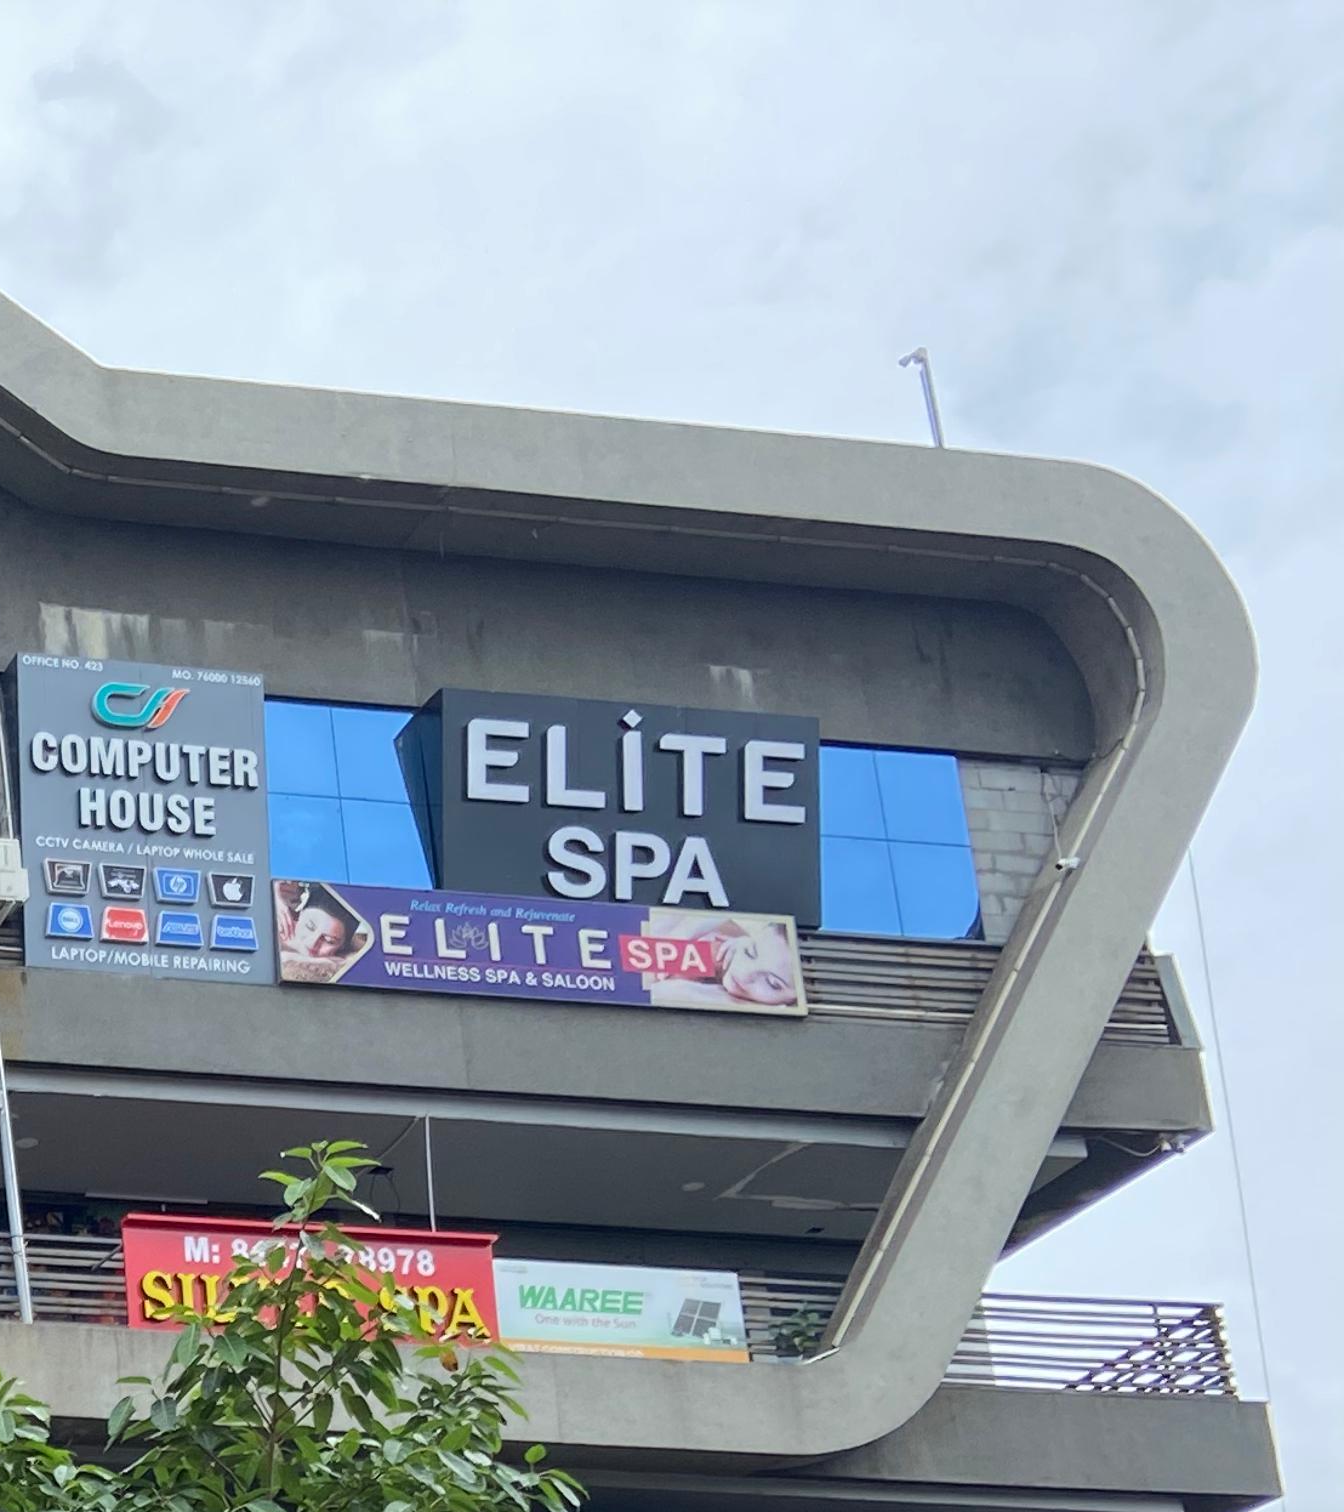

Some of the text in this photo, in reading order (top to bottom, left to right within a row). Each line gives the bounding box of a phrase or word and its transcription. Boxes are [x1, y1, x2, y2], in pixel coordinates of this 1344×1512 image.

[22, 655, 104, 672] OFFICE NO. 423
[172, 669, 194, 682] MO.
[31, 731, 260, 789] COMPUTER
[78, 786, 218, 837] HOUSE
[35, 835, 69, 848] CCTV
[72, 838, 125, 854] CAMERA
[136, 844, 181, 858] LAPTOP
[182, 847, 225, 862] WHOLE
[227, 851, 255, 865] SALE
[546, 825, 730, 908] SPA
[410, 899, 442, 913] Relax
[445, 902, 487, 916] Refresh
[490, 906, 512, 918] and
[381, 913, 707, 973] ELITE SPA
[51, 946, 251, 973] LAPTOP/MOBILE REPAIRING
[385, 960, 616, 991] WELLNESS SPA & SALOON
[183, 1235, 220, 1264] M:
[519, 1284, 645, 1316] WAAREE
[535, 1313, 637, 1329] One with the Sun
